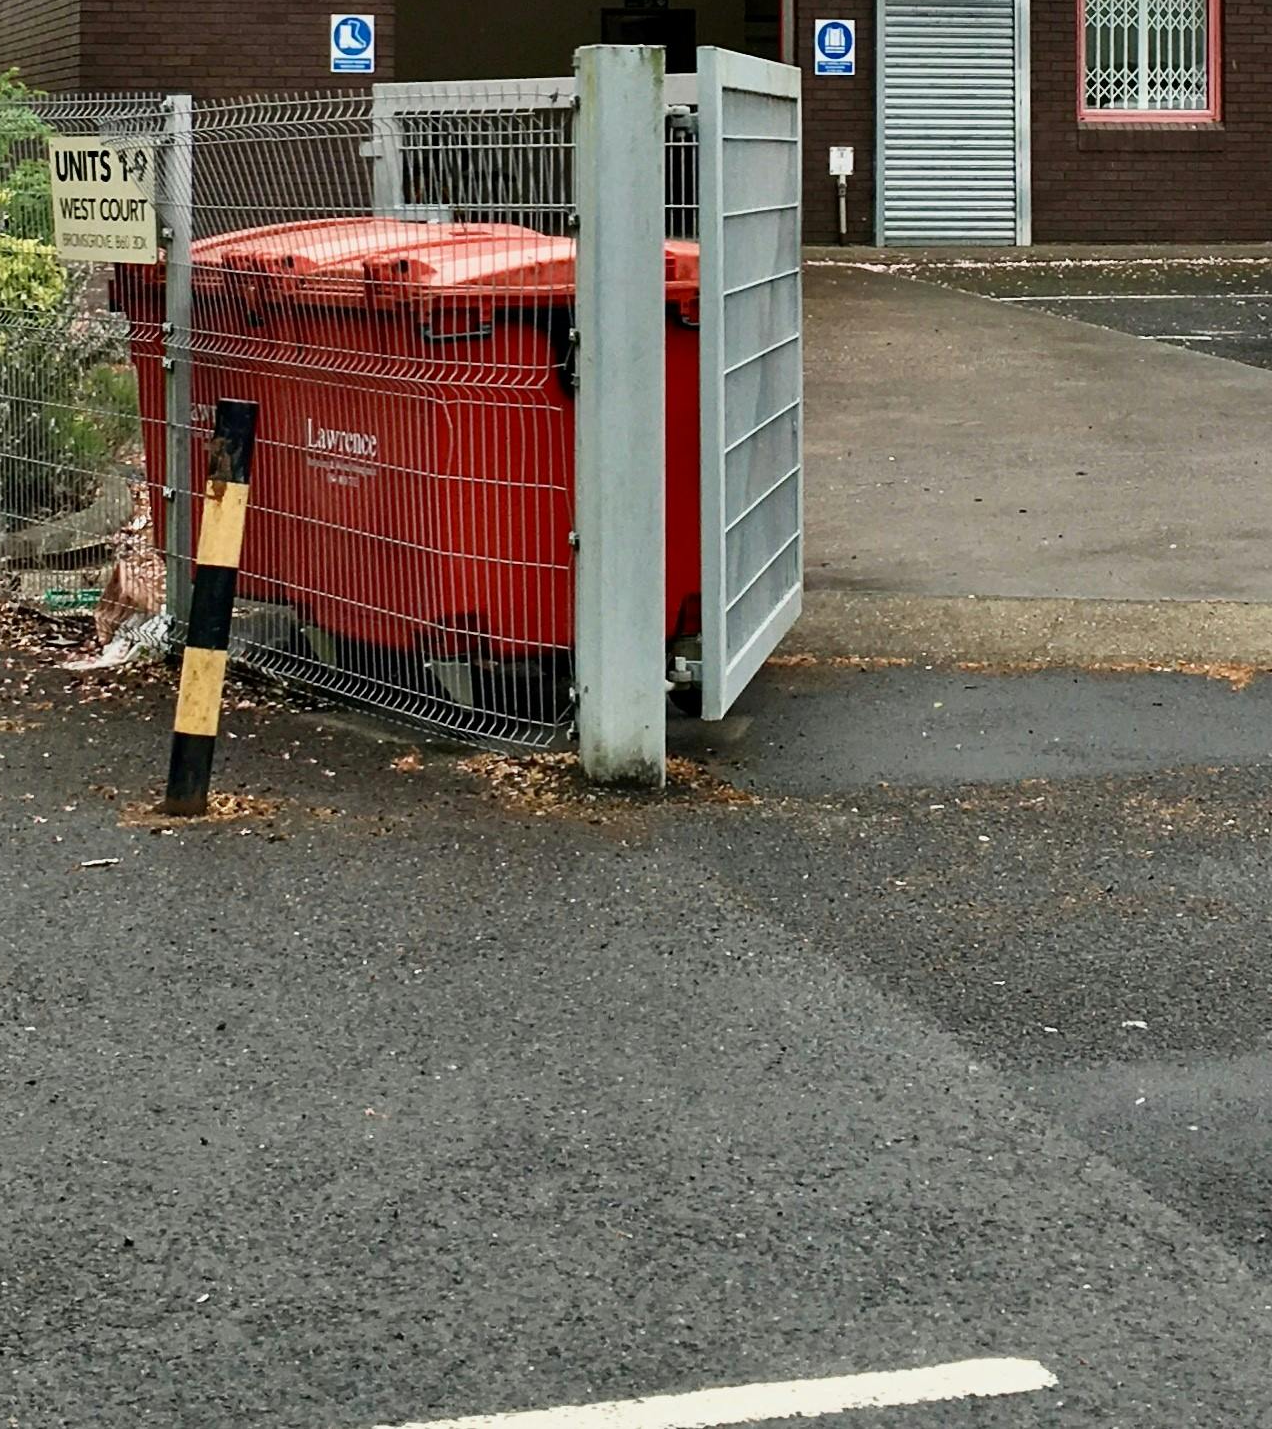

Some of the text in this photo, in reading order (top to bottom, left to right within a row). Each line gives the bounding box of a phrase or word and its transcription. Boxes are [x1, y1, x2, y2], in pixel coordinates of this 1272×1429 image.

[55, 150, 111, 182] UNITS
[60, 198, 147, 221] WEST COURT
[307, 418, 377, 457] Lawrence
